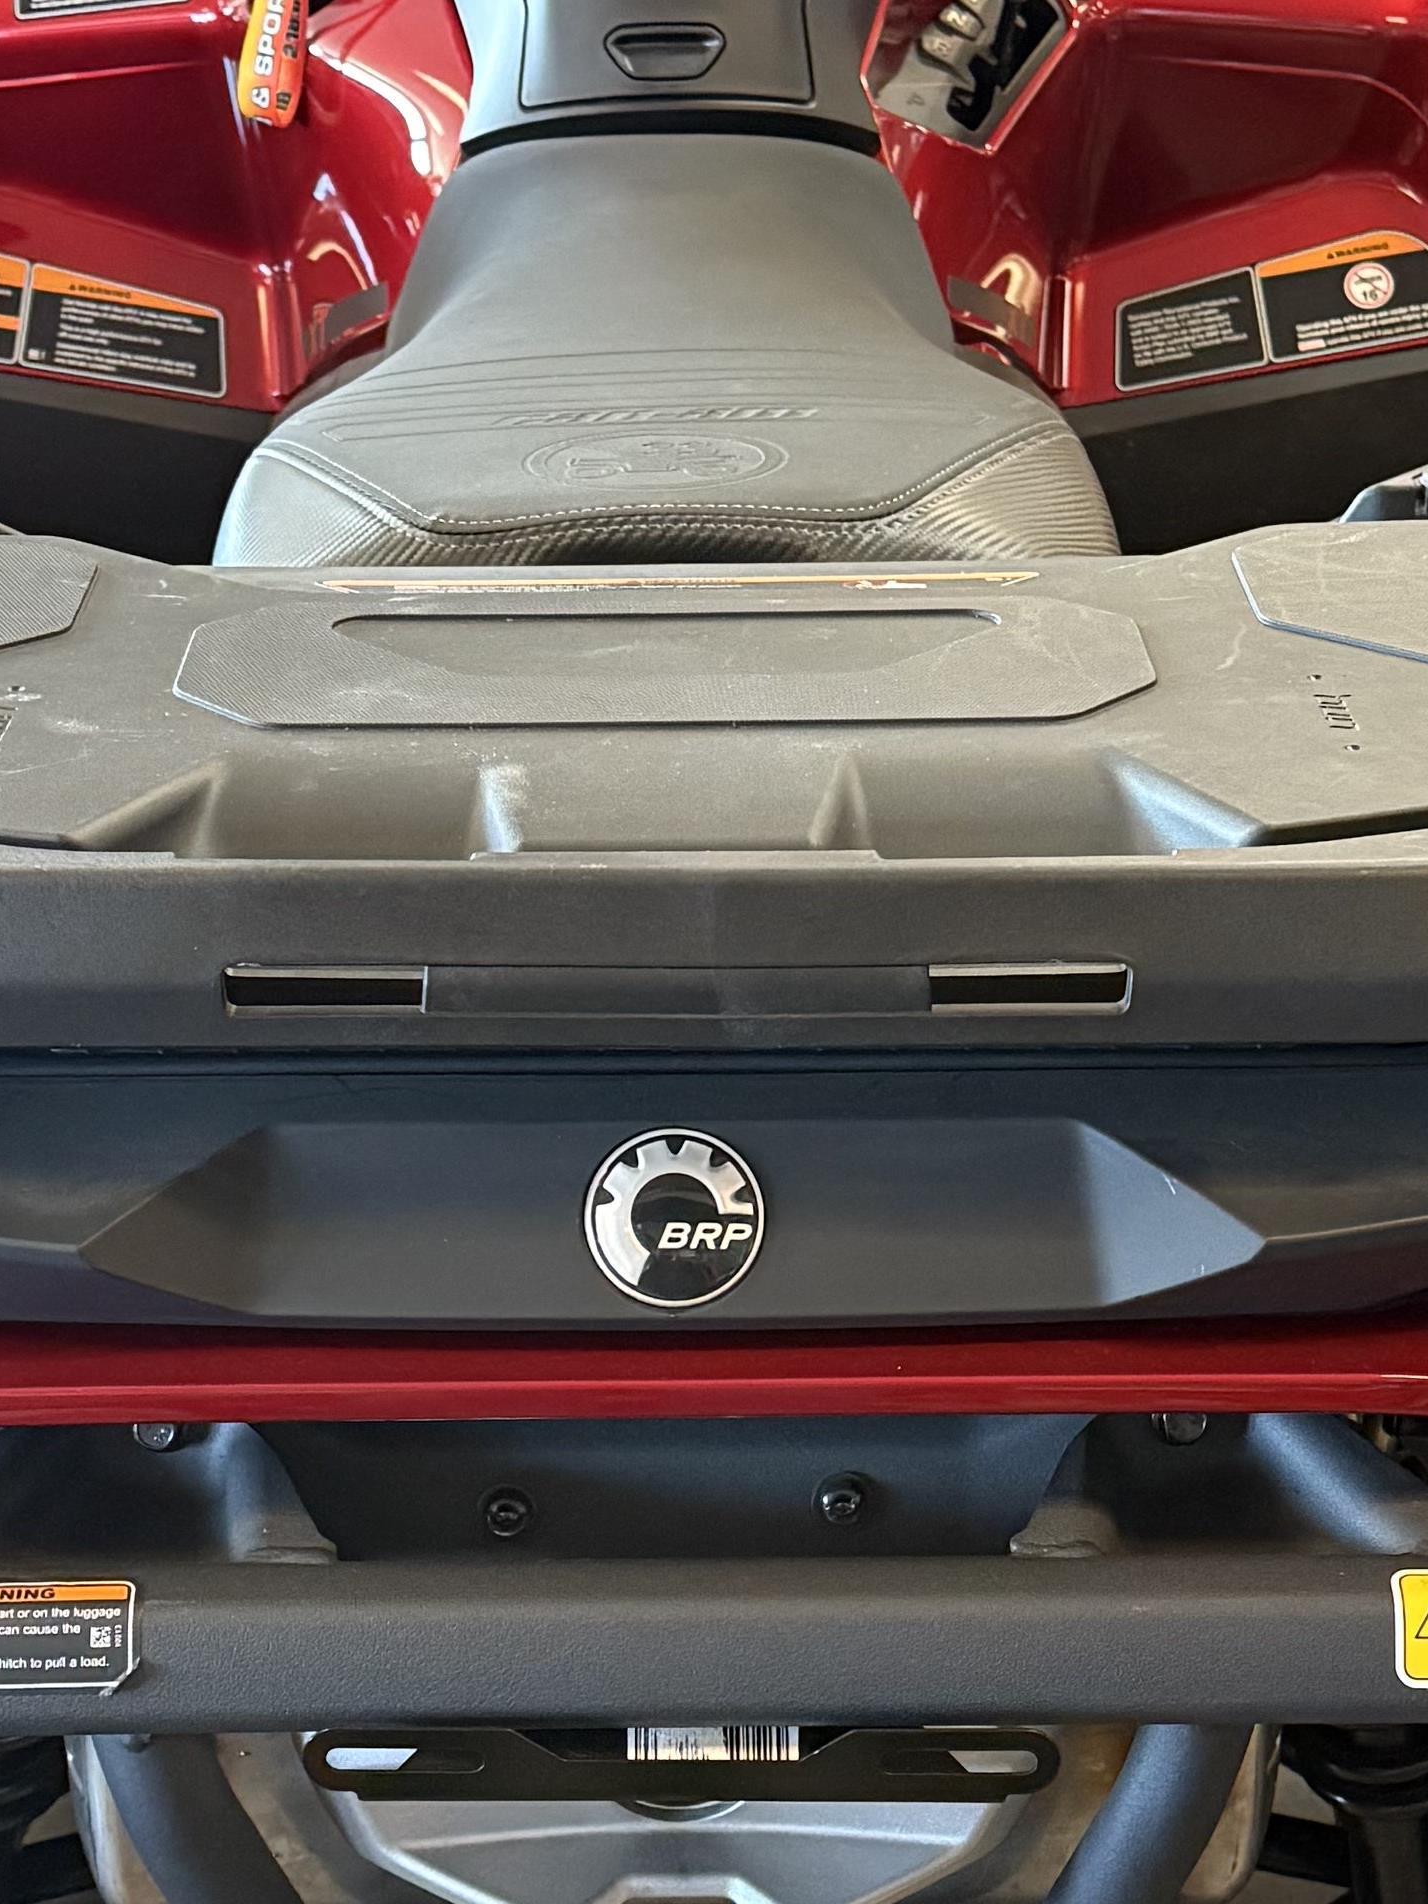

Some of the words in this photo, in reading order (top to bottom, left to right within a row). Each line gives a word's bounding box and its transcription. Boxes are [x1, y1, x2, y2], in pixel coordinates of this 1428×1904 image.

[1363, 289, 1378, 302] 16
[658, 1222, 753, 1250] BRP
[17, 1609, 30, 1619] or
[32, 1609, 48, 1619] on
[51, 1606, 70, 1618] the
[73, 1607, 121, 1620] luggage
[23, 1625, 59, 1635] cause
[62, 1623, 81, 1634] the
[30, 1657, 42, 1669] to
[44, 1657, 66, 1670] pull
[69, 1658, 77, 1668] a
[80, 1656, 110, 1667] load.
